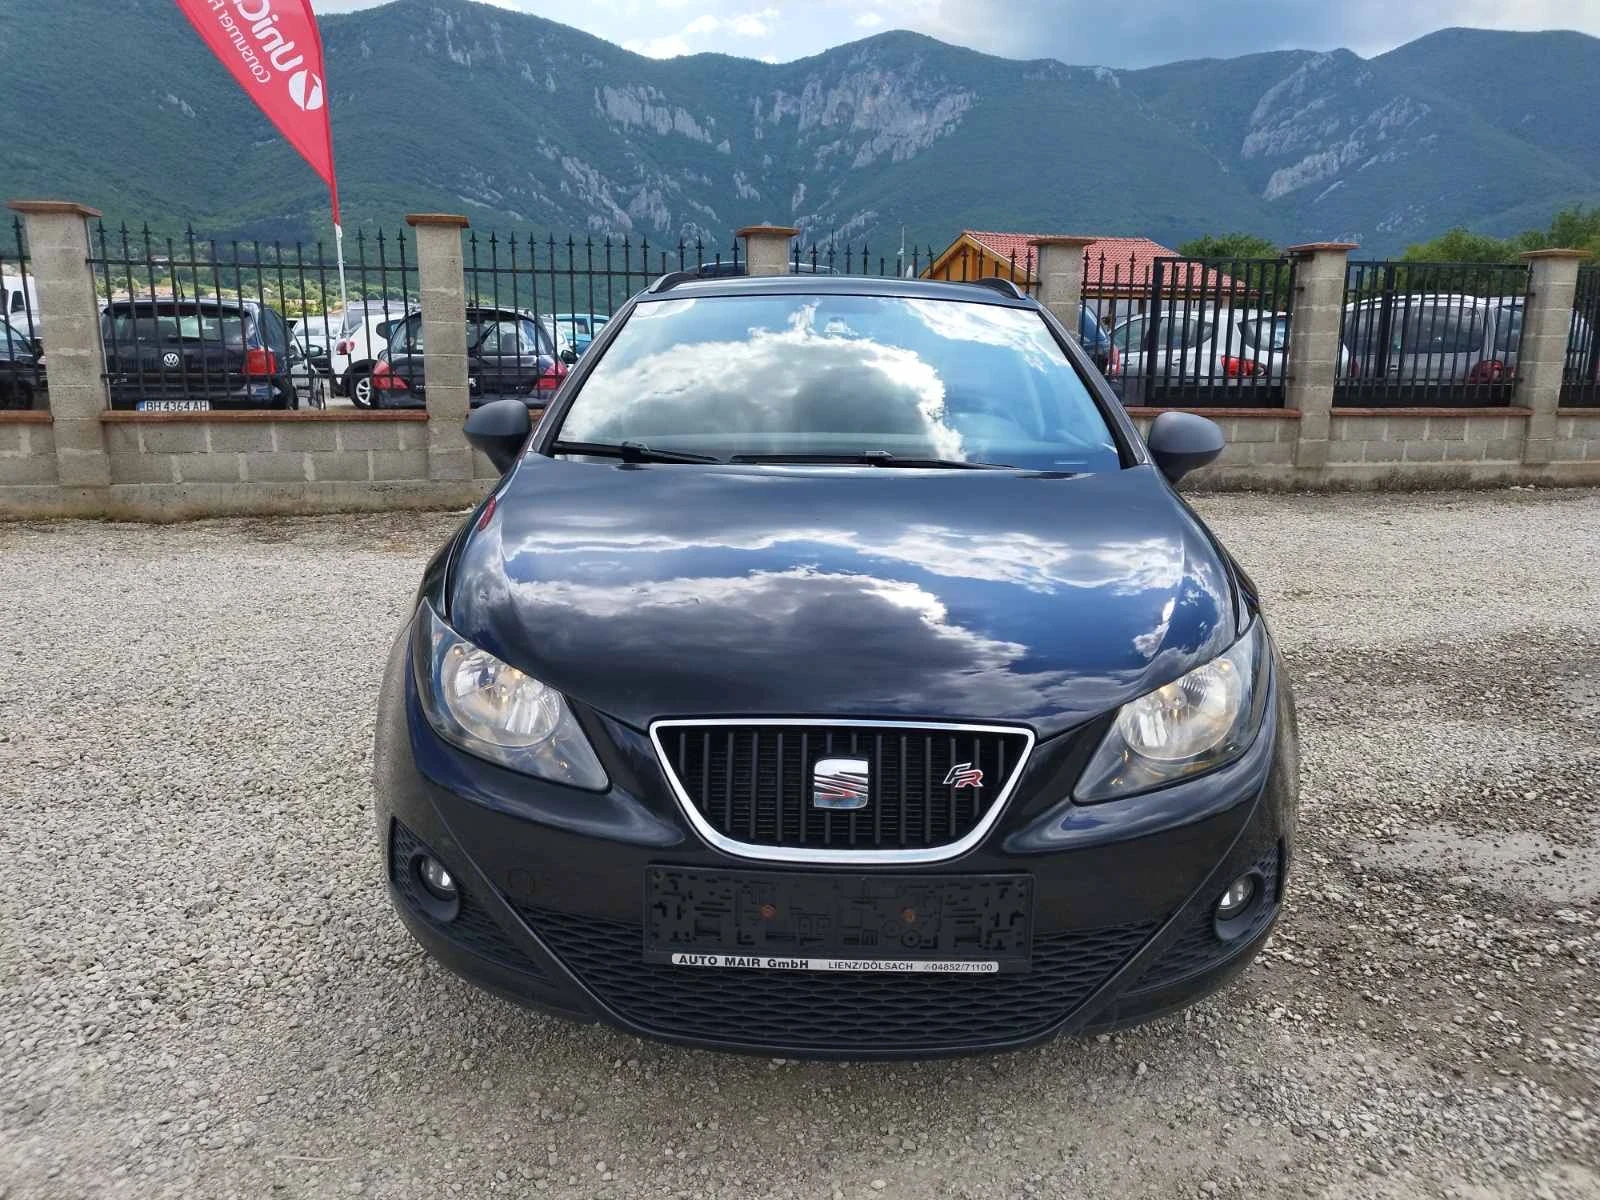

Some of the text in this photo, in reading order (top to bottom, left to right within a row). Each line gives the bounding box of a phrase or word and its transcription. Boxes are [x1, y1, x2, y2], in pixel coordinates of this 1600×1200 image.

[163, 400, 190, 412] 4364
[942, 762, 984, 788] FR
[678, 954, 718, 966] AUTO
[724, 956, 761, 967] MAIR
[767, 958, 809, 969] GmbH
